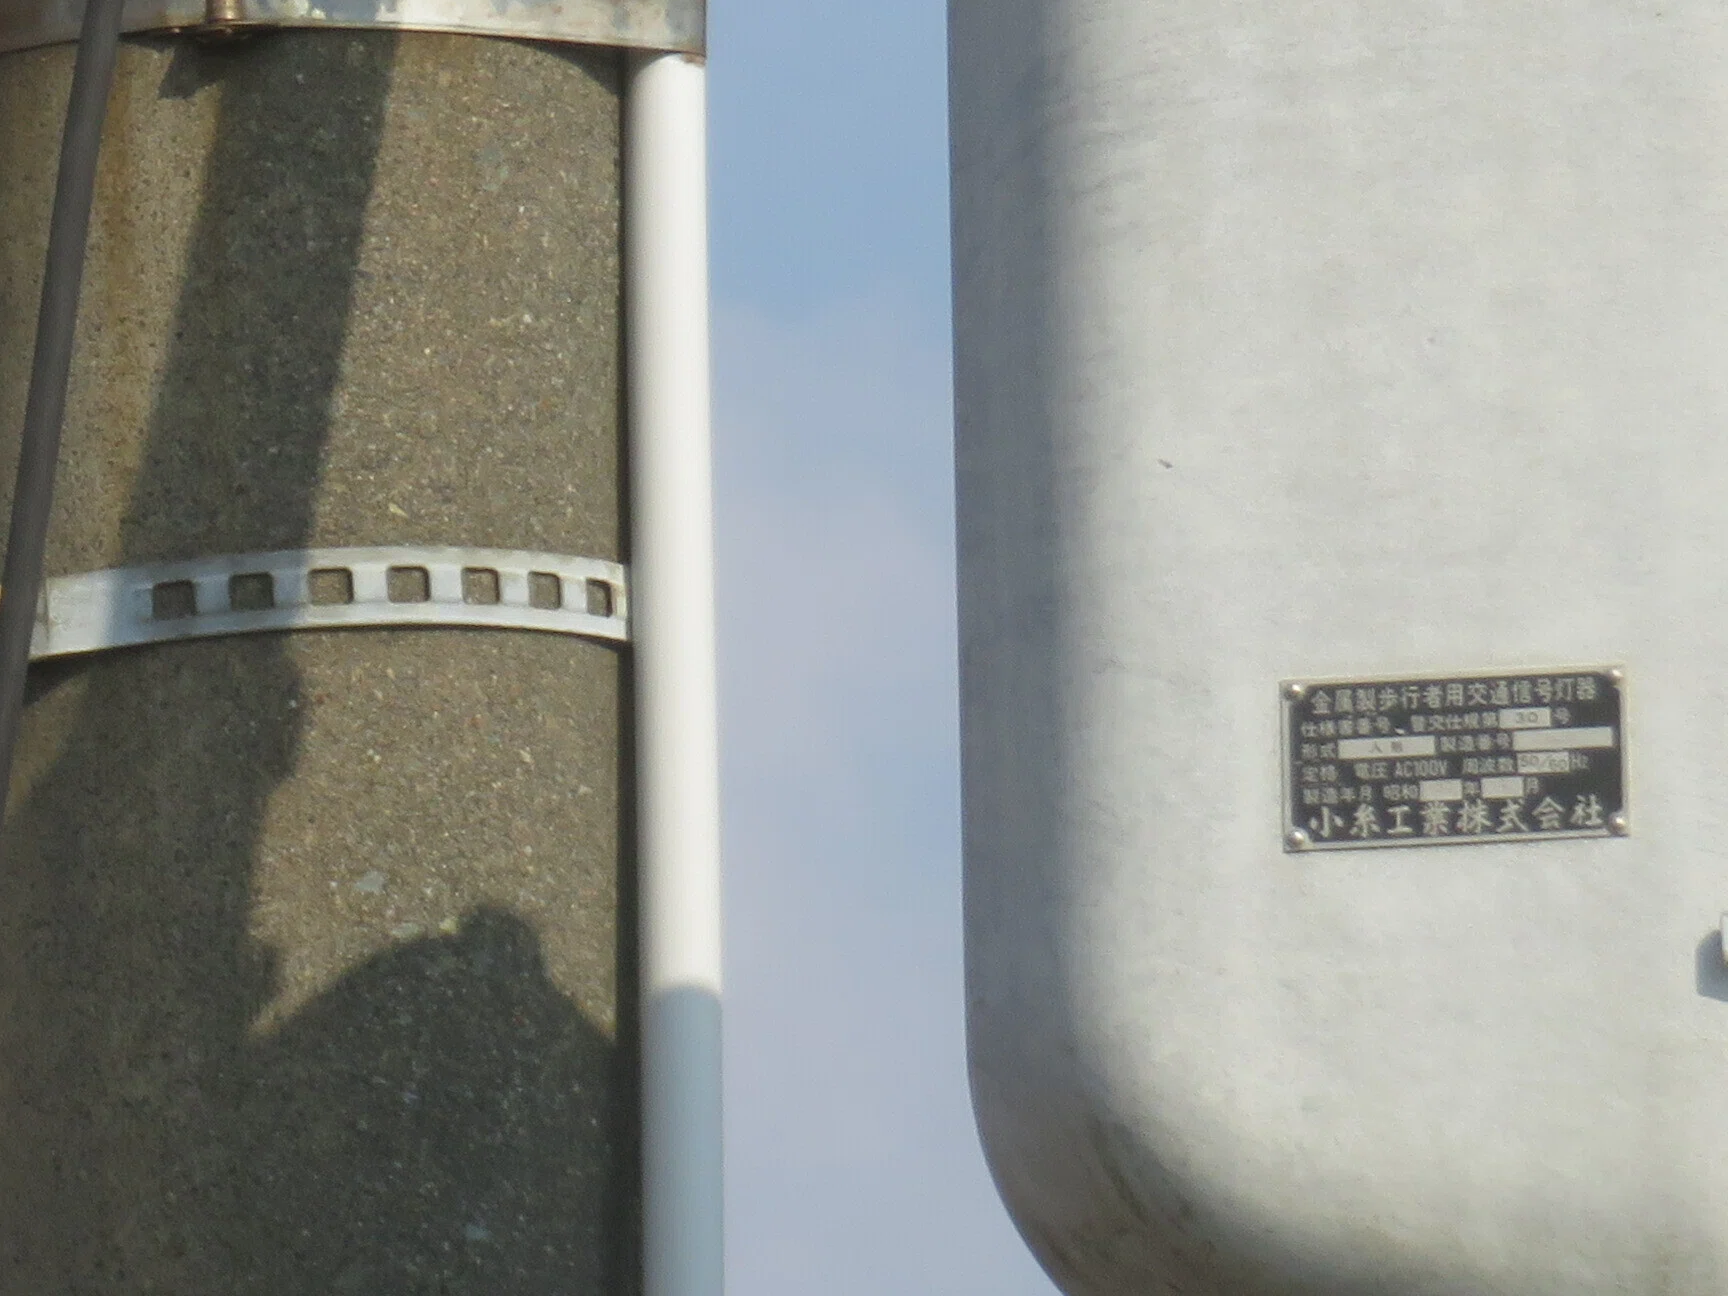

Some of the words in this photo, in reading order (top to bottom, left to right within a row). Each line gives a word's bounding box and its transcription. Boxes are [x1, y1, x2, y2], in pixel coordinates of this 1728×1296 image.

[1310, 794, 1603, 838] 小糸工業株式会社
